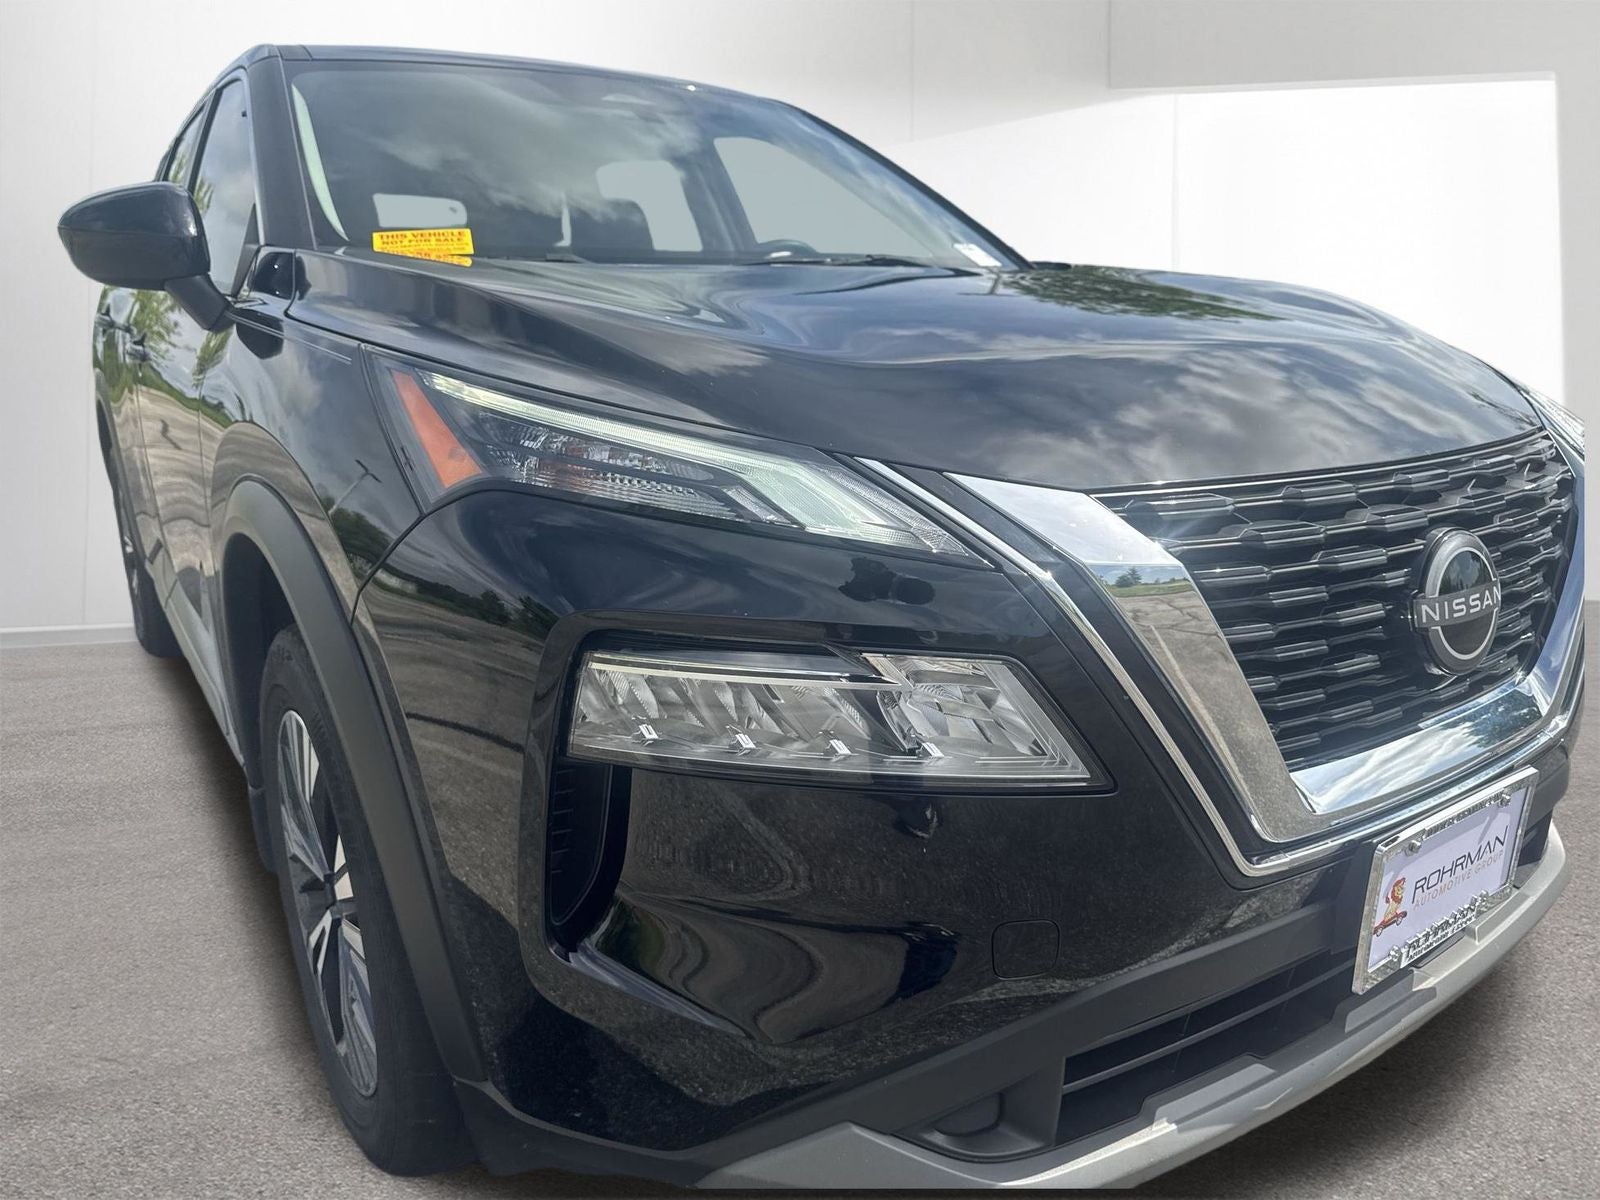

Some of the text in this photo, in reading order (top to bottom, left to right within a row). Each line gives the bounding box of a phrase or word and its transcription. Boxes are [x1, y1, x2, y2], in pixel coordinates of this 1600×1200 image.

[411, 231, 466, 239] VEHICLE
[1421, 585, 1502, 624] NISSAN
[1411, 825, 1509, 905] ROHRMAN
[1413, 851, 1504, 909] AUTOMOTIVE GROUP
